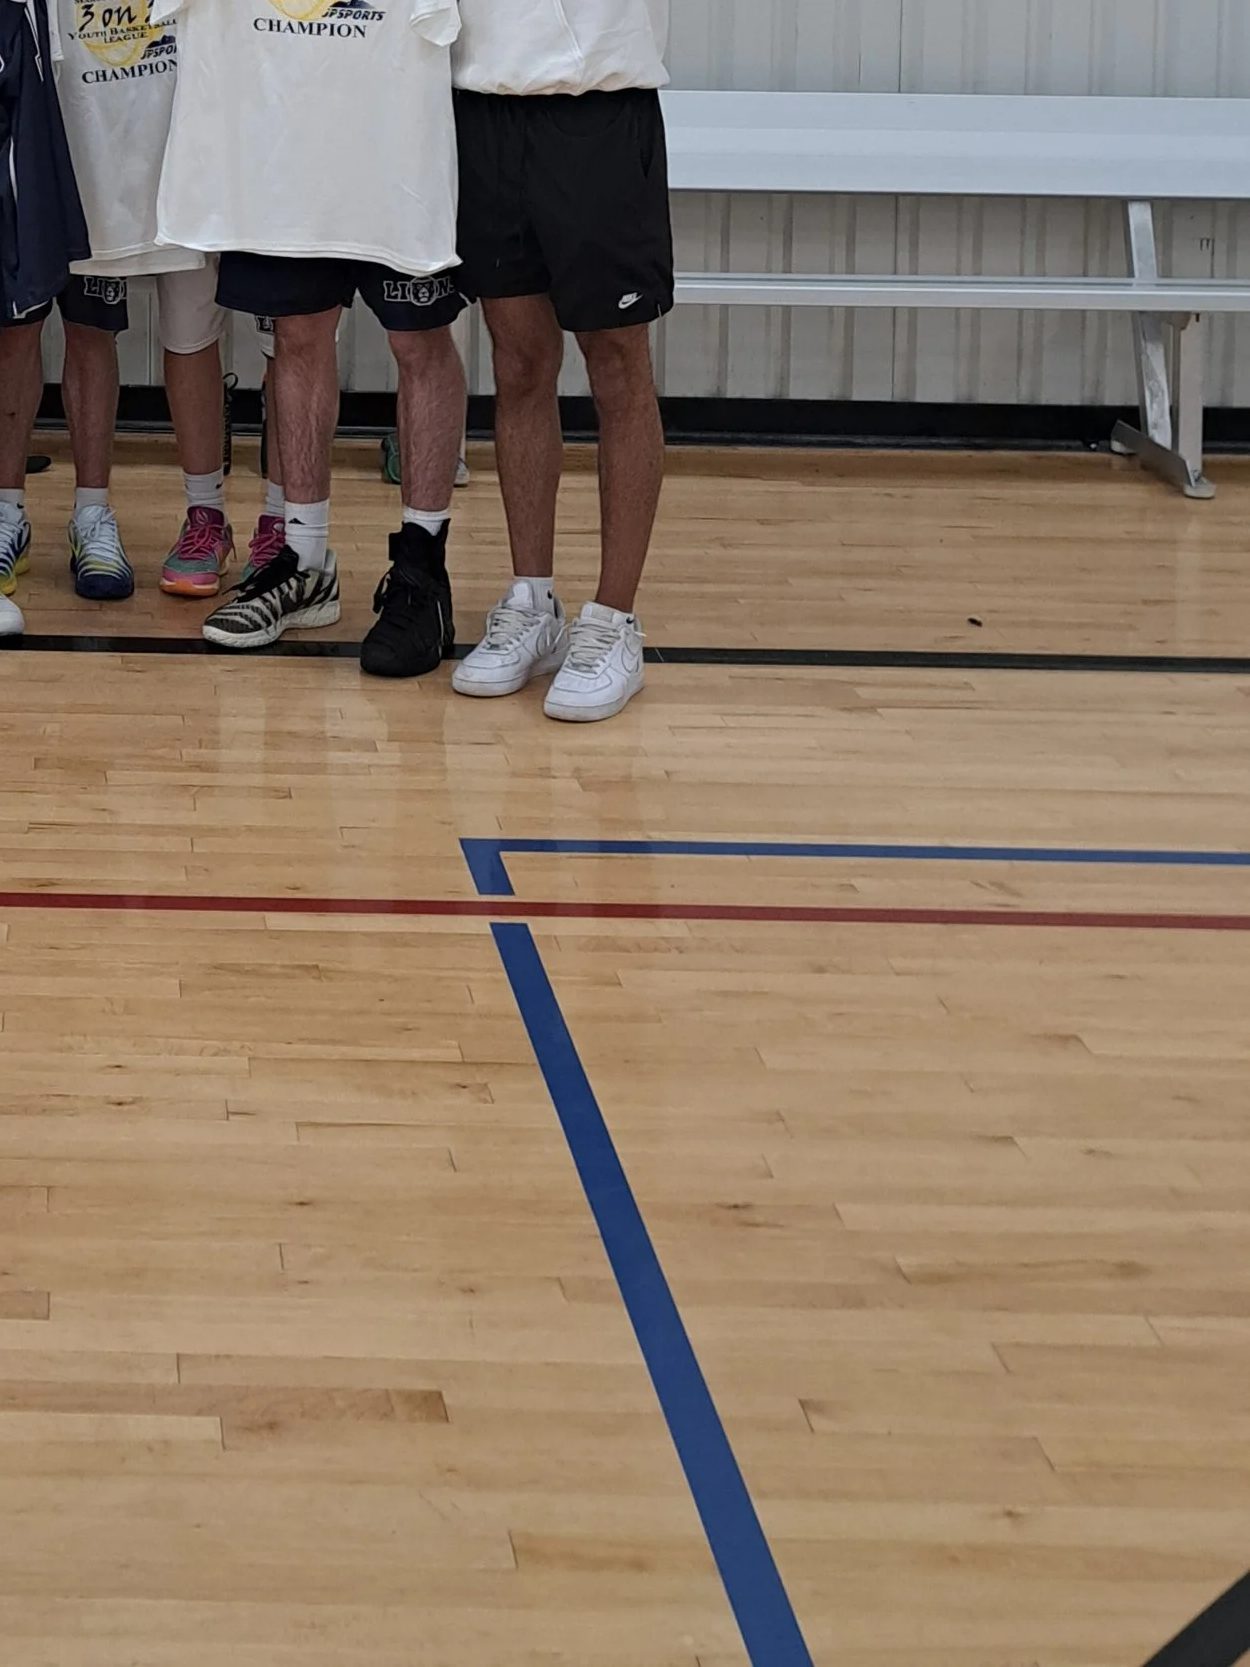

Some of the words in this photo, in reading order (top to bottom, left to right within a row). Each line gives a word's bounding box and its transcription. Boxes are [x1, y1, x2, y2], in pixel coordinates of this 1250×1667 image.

[79, 4, 95, 32] 3
[102, 6, 137, 28] on
[253, 17, 367, 39] CHAMPION
[104, 31, 148, 44] LEAGUE
